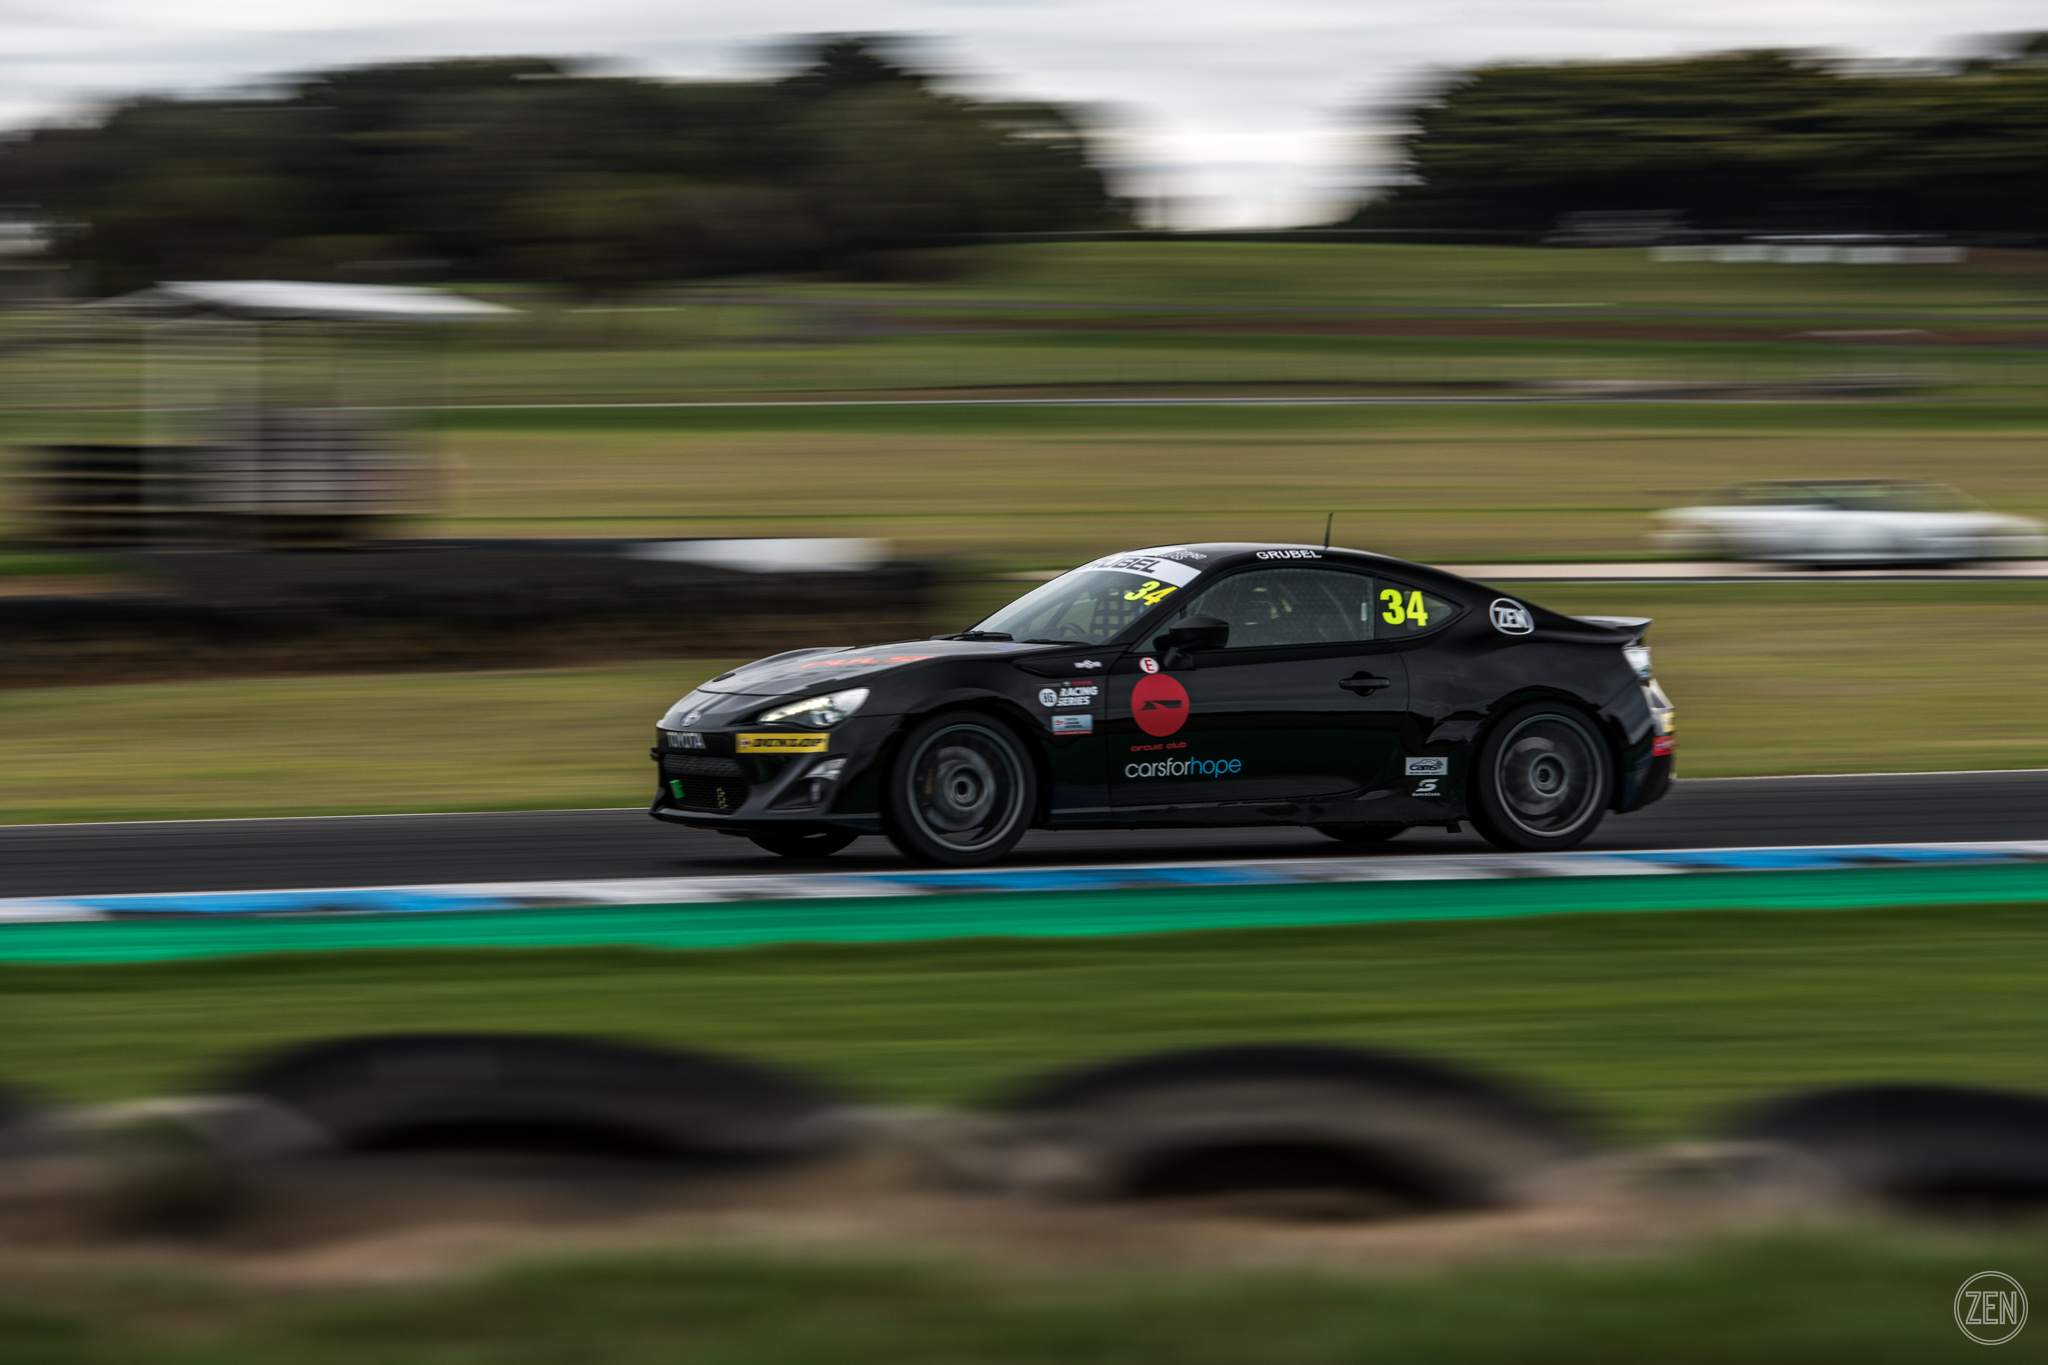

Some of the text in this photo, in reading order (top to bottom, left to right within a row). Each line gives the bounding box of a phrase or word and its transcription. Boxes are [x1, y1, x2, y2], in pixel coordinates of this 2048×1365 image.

[1256, 550, 1322, 560] GRUBEL
[1124, 581, 1178, 606] 34
[1380, 588, 1428, 626] 34
[1145, 659, 1155, 671] E
[1059, 686, 1098, 696] RACING
[1056, 696, 1091, 706] SERIES
[666, 732, 706, 749] TOYOTA
[751, 738, 824, 748] DUNLOP
[1166, 741, 1187, 749] club
[1125, 756, 1241, 778] carsforhope
